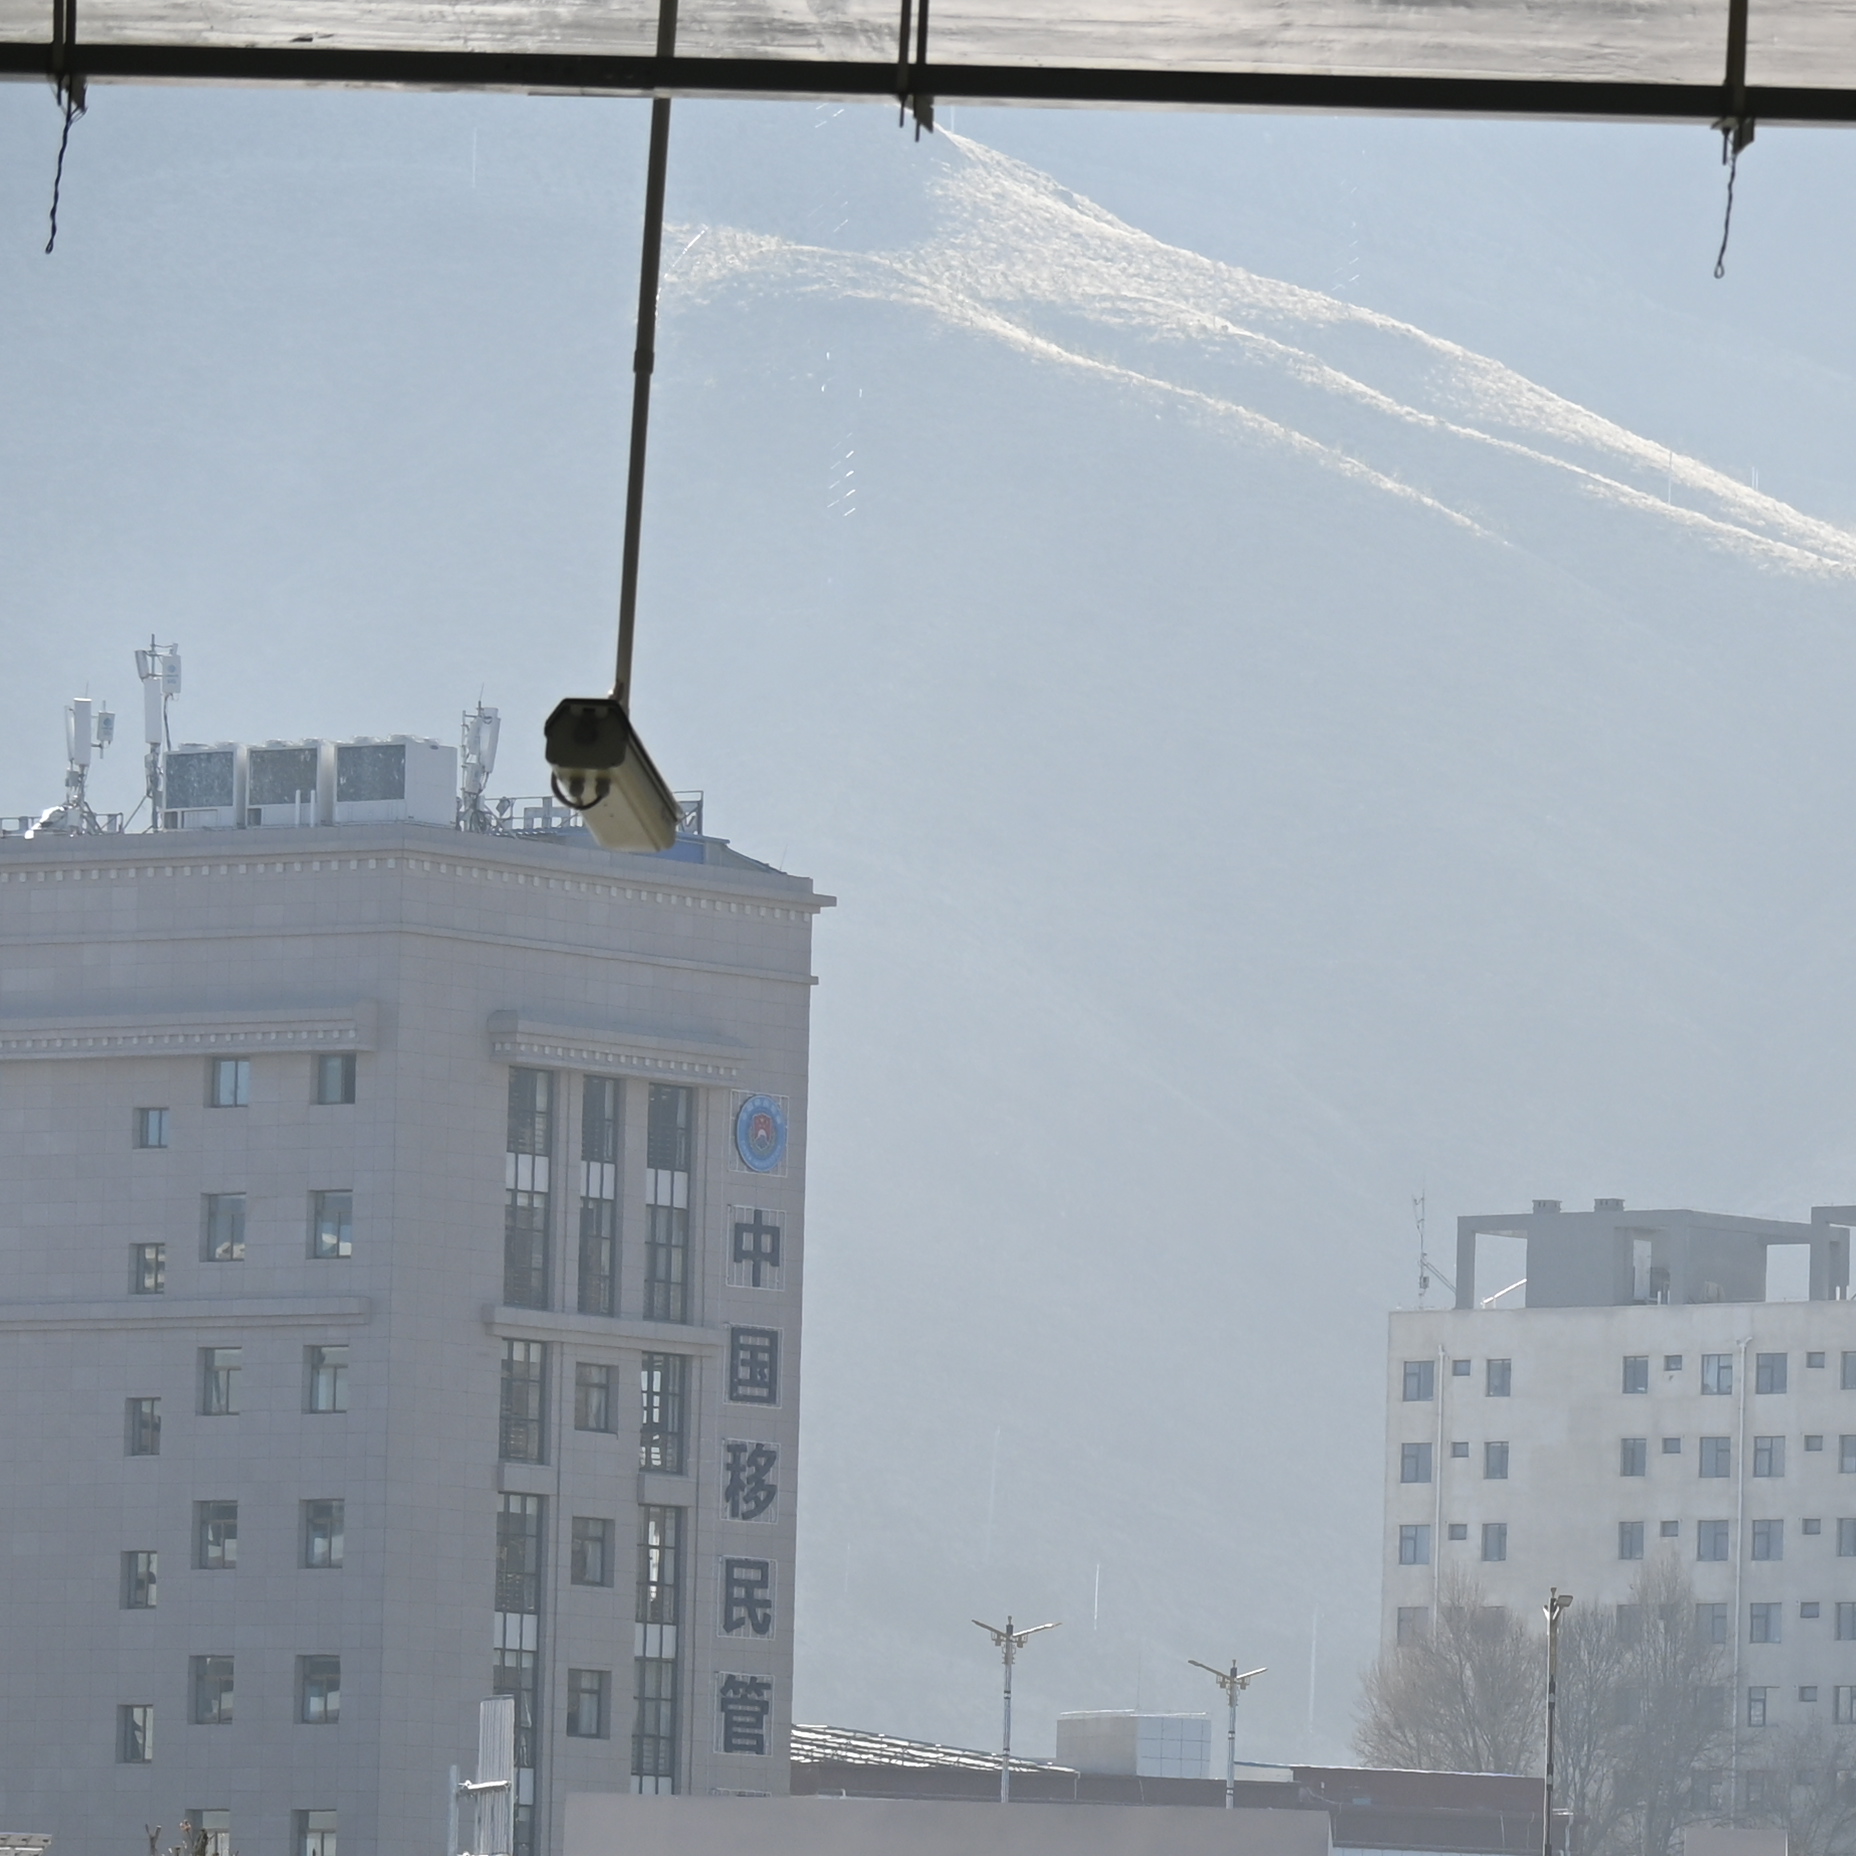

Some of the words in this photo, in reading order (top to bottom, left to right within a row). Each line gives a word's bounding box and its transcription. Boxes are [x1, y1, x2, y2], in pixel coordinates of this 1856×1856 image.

[718, 1209, 782, 1797] 中国移民管
